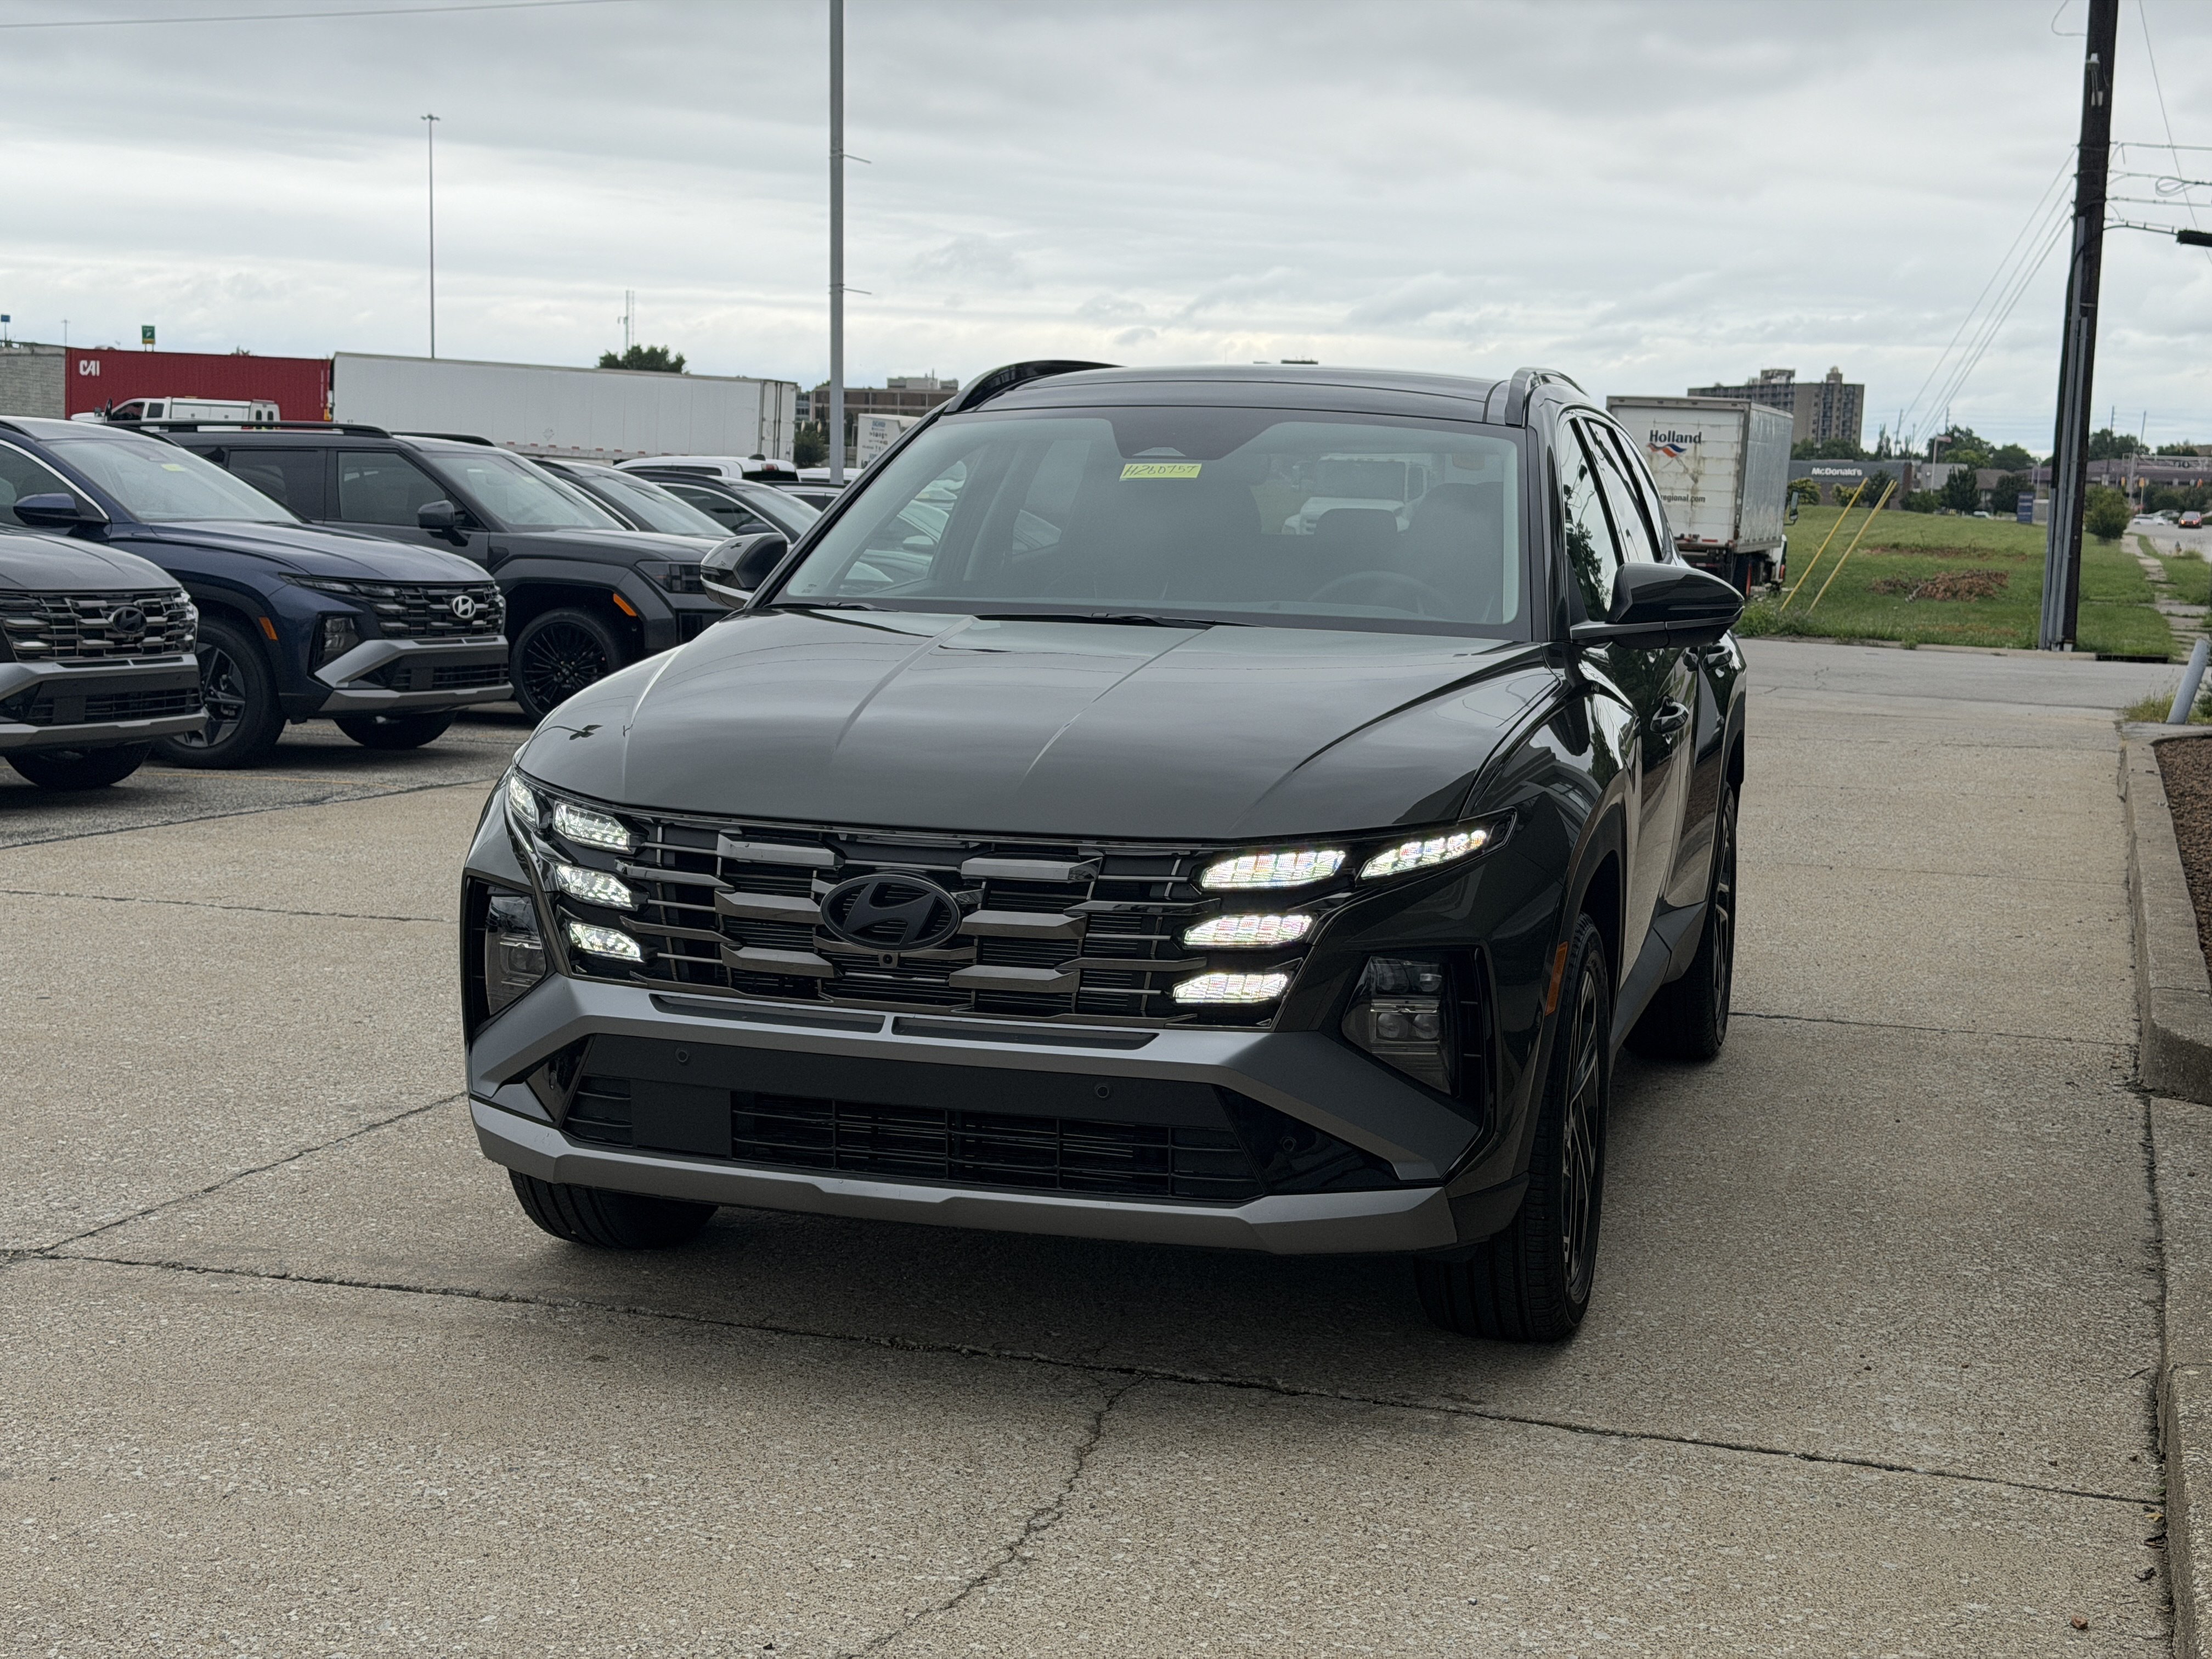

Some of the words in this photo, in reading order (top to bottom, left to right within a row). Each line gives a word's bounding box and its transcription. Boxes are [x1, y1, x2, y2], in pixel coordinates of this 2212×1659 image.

[80, 360, 100, 377] CAI
[1649, 430, 1702, 444] Holland
[1812, 467, 1863, 476] McDonald's
[1660, 494, 1706, 503] regional.com
